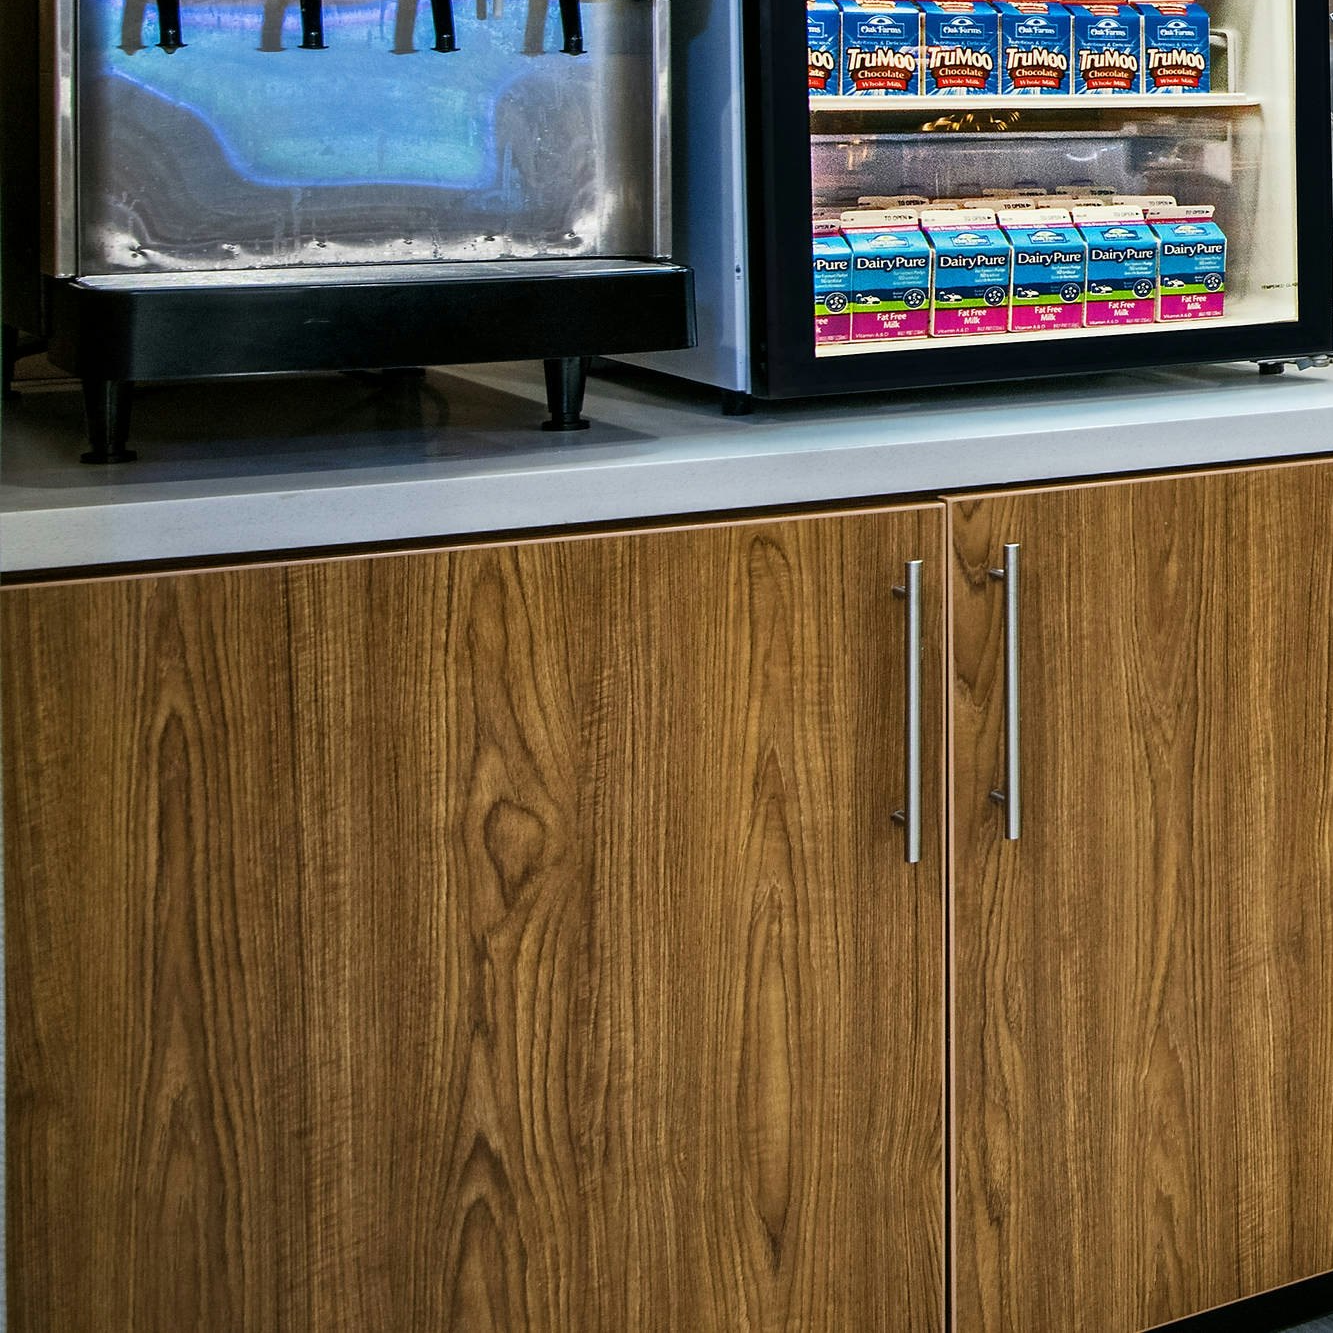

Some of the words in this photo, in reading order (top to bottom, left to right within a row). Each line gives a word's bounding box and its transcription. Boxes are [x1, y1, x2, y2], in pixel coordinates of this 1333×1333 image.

[878, 26, 901, 34] Farms
[943, 26, 958, 34] Oak
[959, 26, 982, 34] Farms
[1018, 26, 1033, 34] Oak
[1034, 26, 1055, 34] Farms
[1090, 28, 1105, 36] Oak
[1106, 28, 1126, 36] Farms
[1160, 28, 1174, 36] Oak
[1175, 28, 1195, 36] Farms
[847, 48, 915, 71] TruMoo
[928, 47, 993, 71] TruMoo
[1006, 47, 1067, 71] TruMoo
[1079, 49, 1138, 72] TruMoo
[1147, 48, 1205, 70] TruMoo
[858, 70, 905, 79] Chocolate
[939, 68, 983, 77] Chocolate
[1016, 69, 1058, 77] Chocolate
[1088, 70, 1129, 79] Chocolate
[1157, 68, 1198, 76] Chocolate
[1164, 244, 1223, 257] DairyPure
[1018, 252, 1081, 265] DairyPure
[1091, 249, 1153, 262] DairyPure
[857, 257, 926, 271] DairyPure
[940, 255, 1006, 269] DairyPure
[1120, 301, 1135, 309] Free
[970, 308, 987, 316] Free
[1034, 306, 1046, 314] Fat
[890, 312, 907, 320] Free
[963, 316, 980, 325] Milk
[1040, 313, 1056, 321] Milk
[883, 320, 900, 329] Milk
